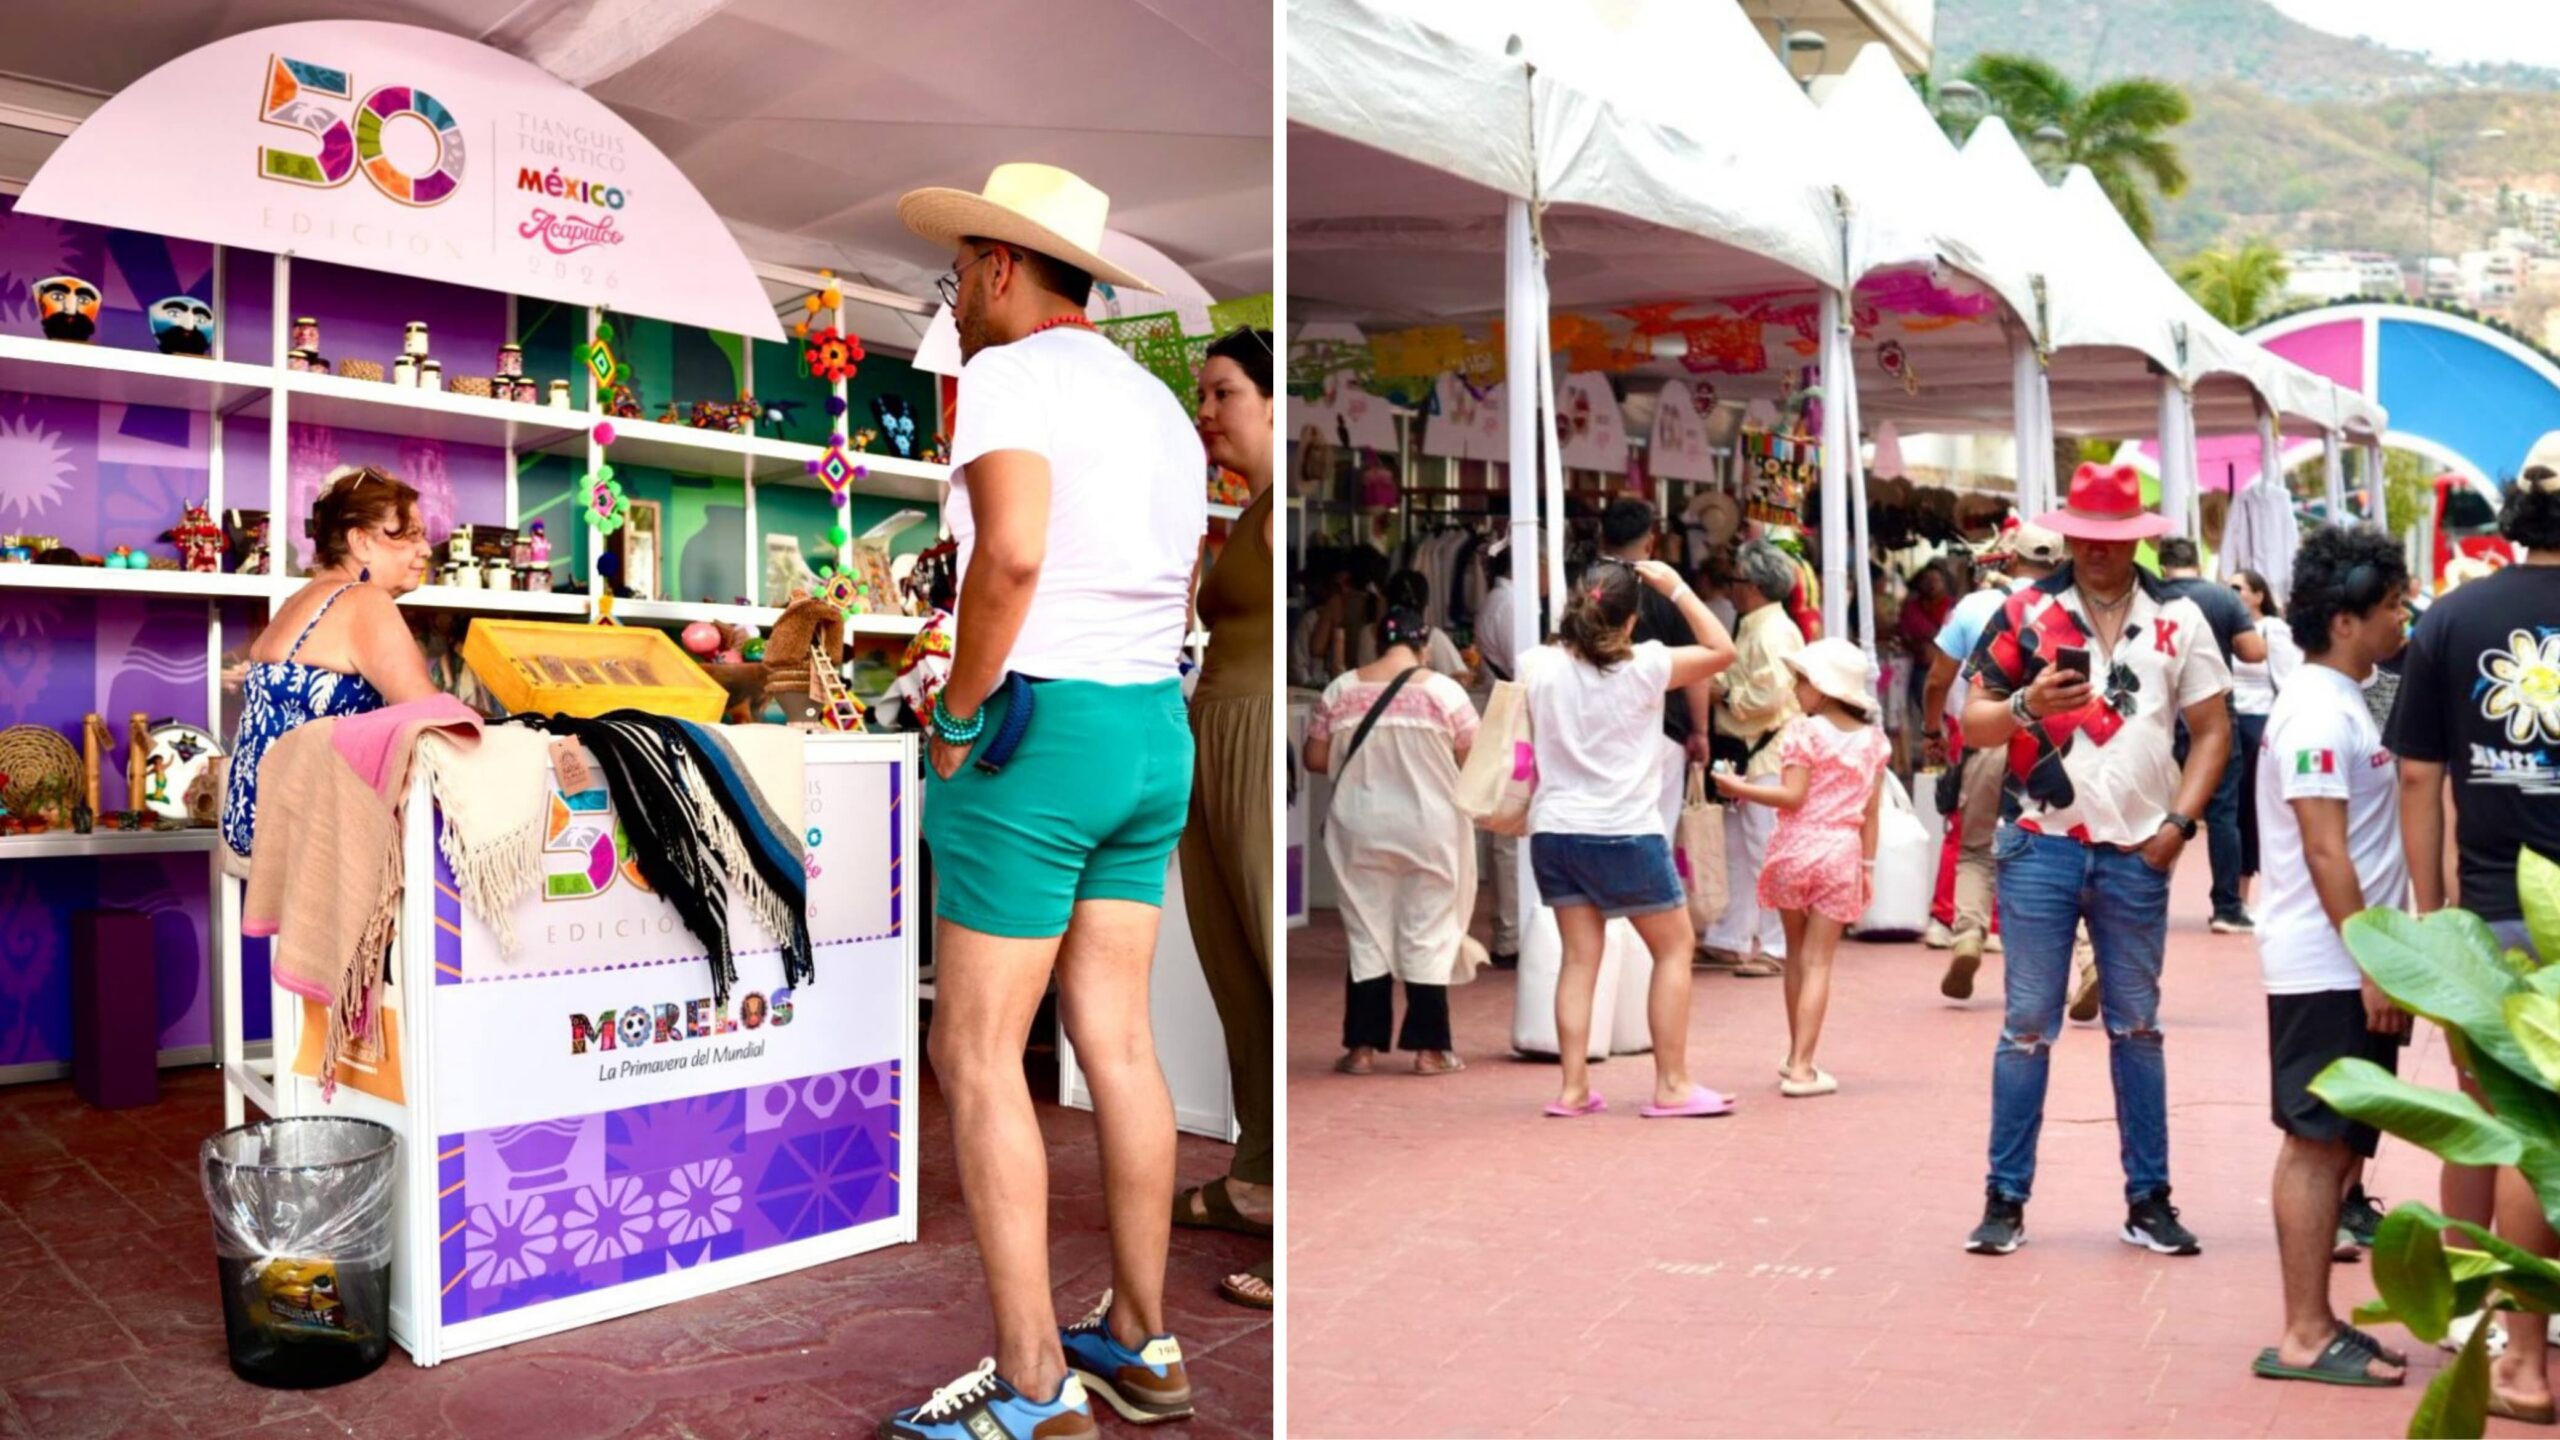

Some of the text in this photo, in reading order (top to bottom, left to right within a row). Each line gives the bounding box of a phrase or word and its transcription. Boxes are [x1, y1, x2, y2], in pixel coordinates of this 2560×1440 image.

[258, 52, 467, 208] 50
[516, 111, 626, 155] TIANGUIS
[516, 164, 627, 211] México
[516, 206, 626, 255] Acapulco
[527, 255, 620, 290] 2026
[2153, 617, 2179, 658] K
[568, 986, 796, 1056] MORELOS
[598, 1038, 766, 1082] La Primavera del Mundial
